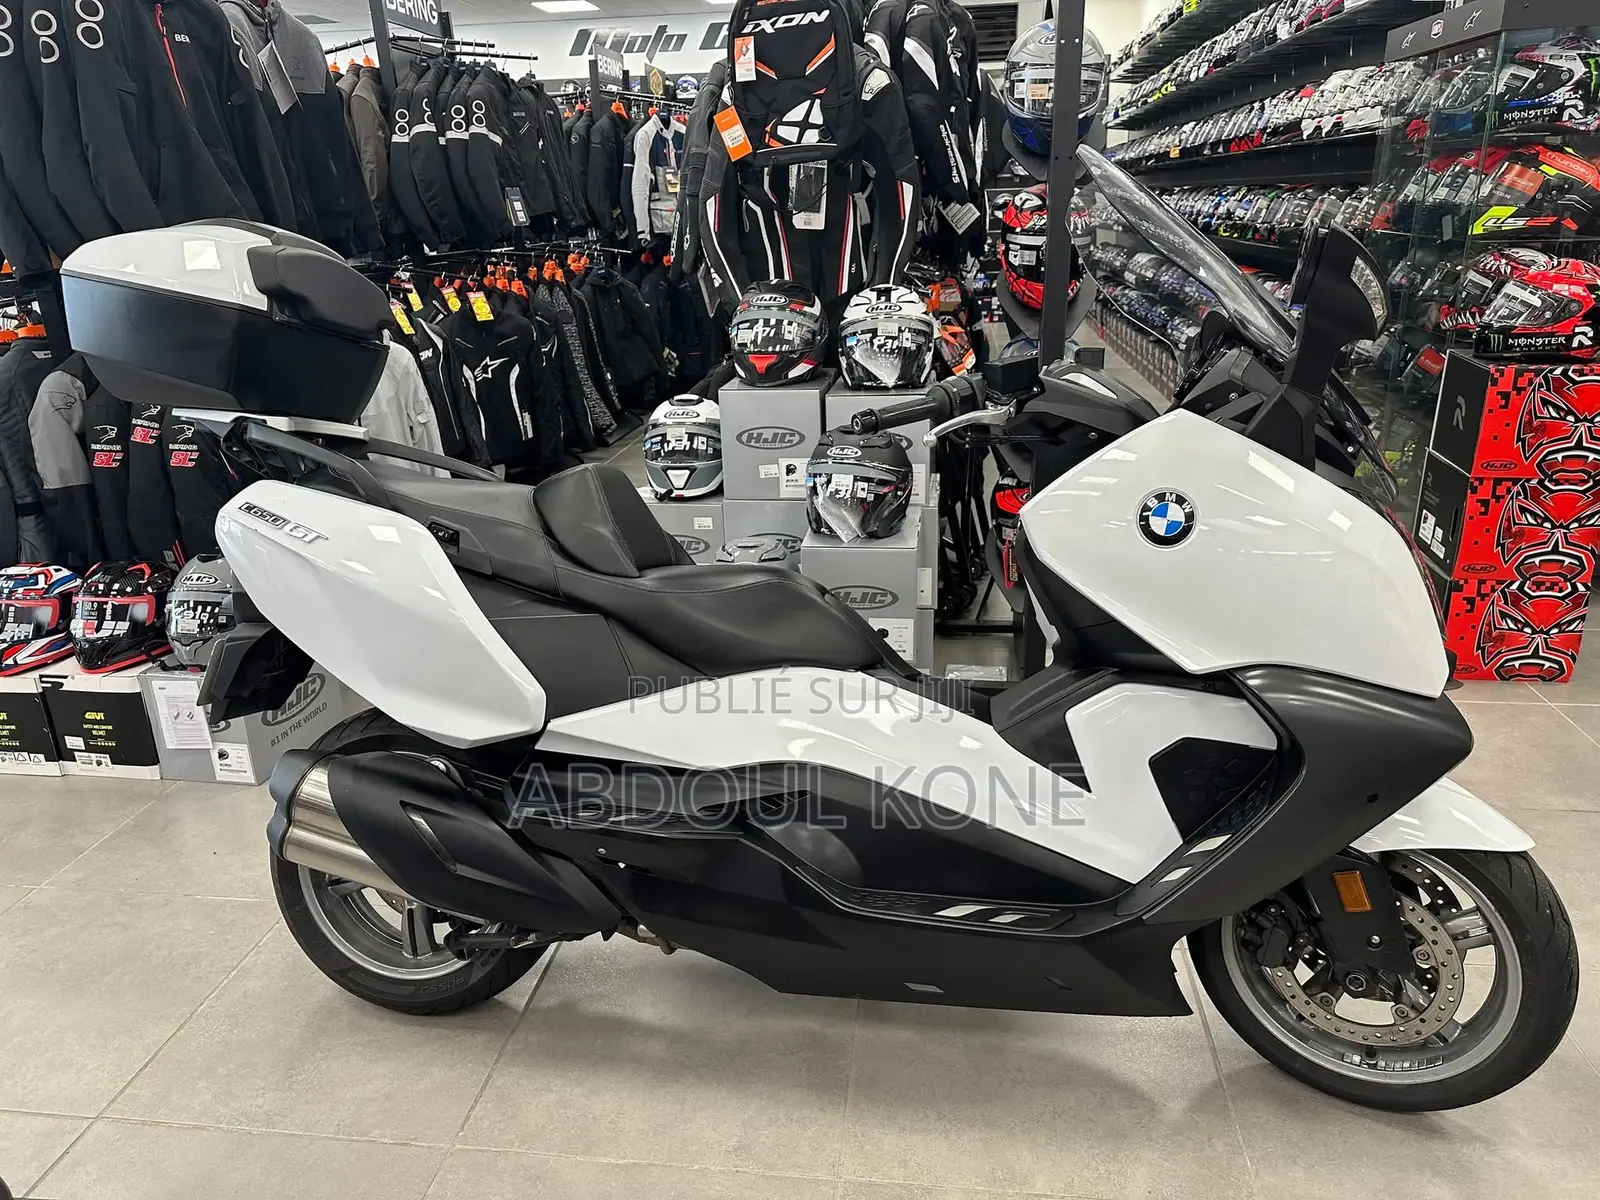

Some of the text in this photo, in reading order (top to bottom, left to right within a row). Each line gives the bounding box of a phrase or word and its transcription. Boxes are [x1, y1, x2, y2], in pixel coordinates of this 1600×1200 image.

[597, 52, 623, 80] BERING
[755, 295, 783, 303] HJC
[870, 304, 898, 313] HJC
[745, 432, 796, 444] HJC
[832, 448, 856, 456] HJC
[1485, 461, 1514, 471] HJC
[1146, 492, 1193, 513] BMW
[239, 502, 329, 545] C650 GT
[1467, 564, 1493, 573] HJC
[183, 575, 213, 583] HJC
[84, 711, 105, 720] GIVI
[270, 735, 281, 748] #1
[281, 729, 289, 740] IN
[289, 718, 303, 734] THE
[302, 702, 328, 724] WORLD
